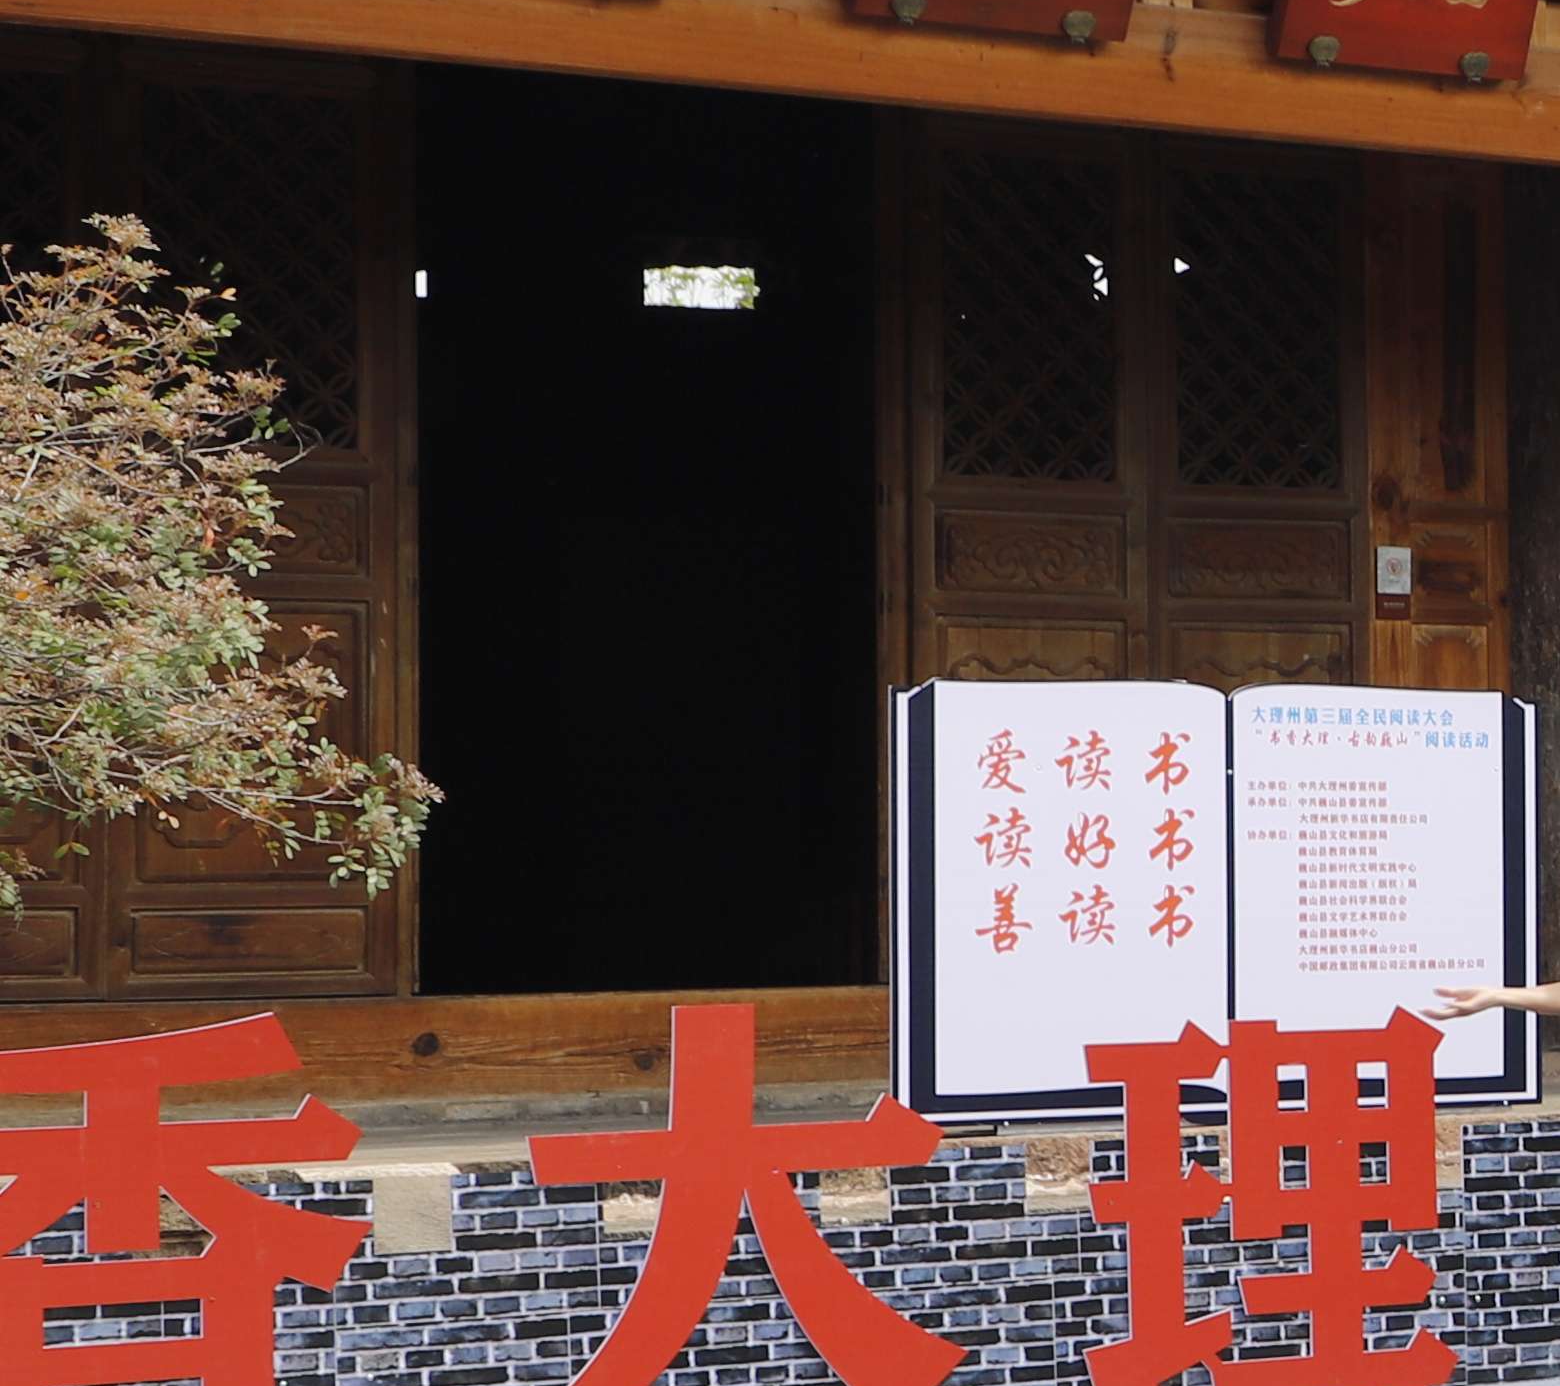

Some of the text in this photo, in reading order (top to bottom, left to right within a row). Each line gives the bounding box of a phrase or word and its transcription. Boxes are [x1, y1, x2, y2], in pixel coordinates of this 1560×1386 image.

[1253, 707, 1453, 726] 大理州第三届全民阅读大会
[977, 729, 1191, 795] 爱读书
[974, 807, 1196, 871] 读好书
[975, 883, 1196, 954] 善读书
